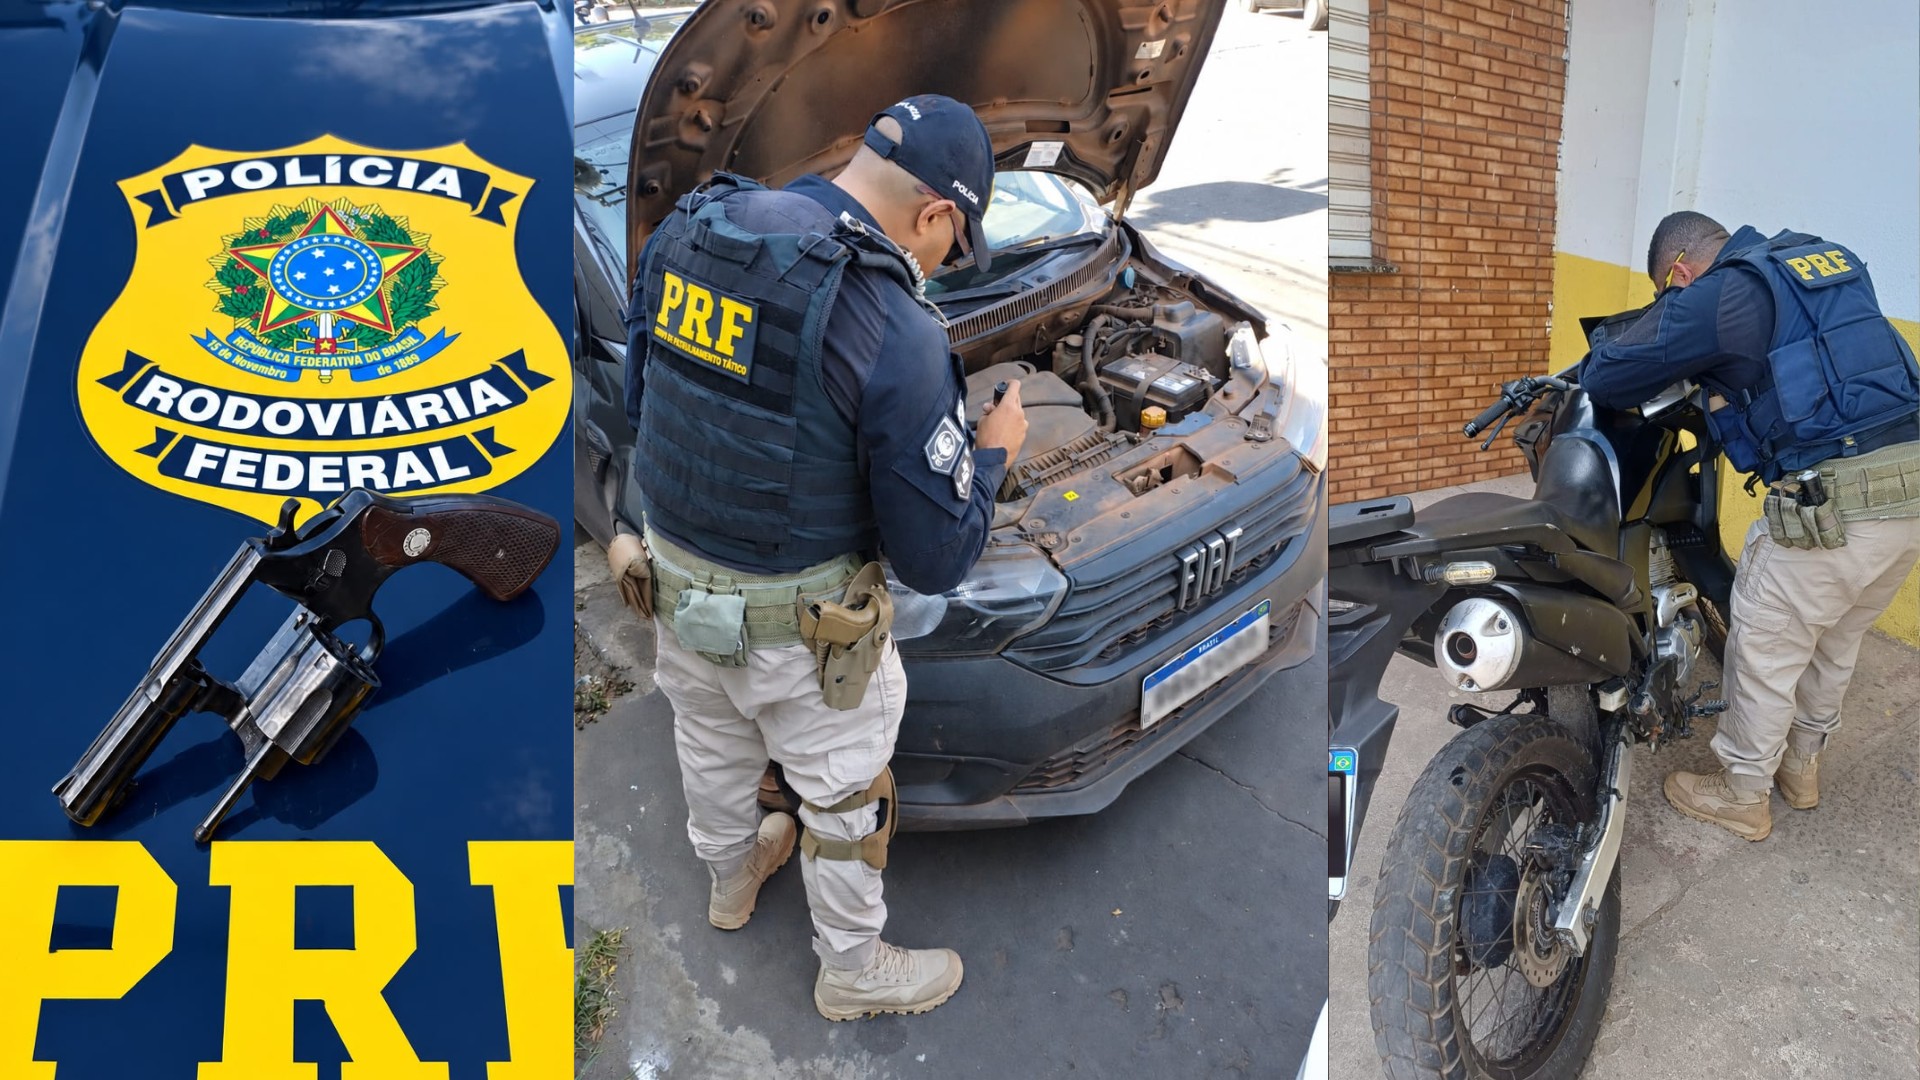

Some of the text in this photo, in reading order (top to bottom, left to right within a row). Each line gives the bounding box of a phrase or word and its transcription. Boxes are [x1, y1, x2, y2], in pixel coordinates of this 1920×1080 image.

[181, 156, 463, 200] POLÍCIA
[1785, 250, 1852, 280] PRF
[657, 271, 752, 356] PRF
[206, 339, 288, 379] 15 de Novembro
[293, 355, 363, 367] FEDERATIVA
[364, 351, 381, 363] DO
[381, 335, 420, 357] BRASIL
[376, 364, 393, 376] de
[135, 374, 513, 437] RODOVIÁRIA
[184, 443, 471, 492] FEDERAL
[1180, 527, 1243, 610] FIAT
